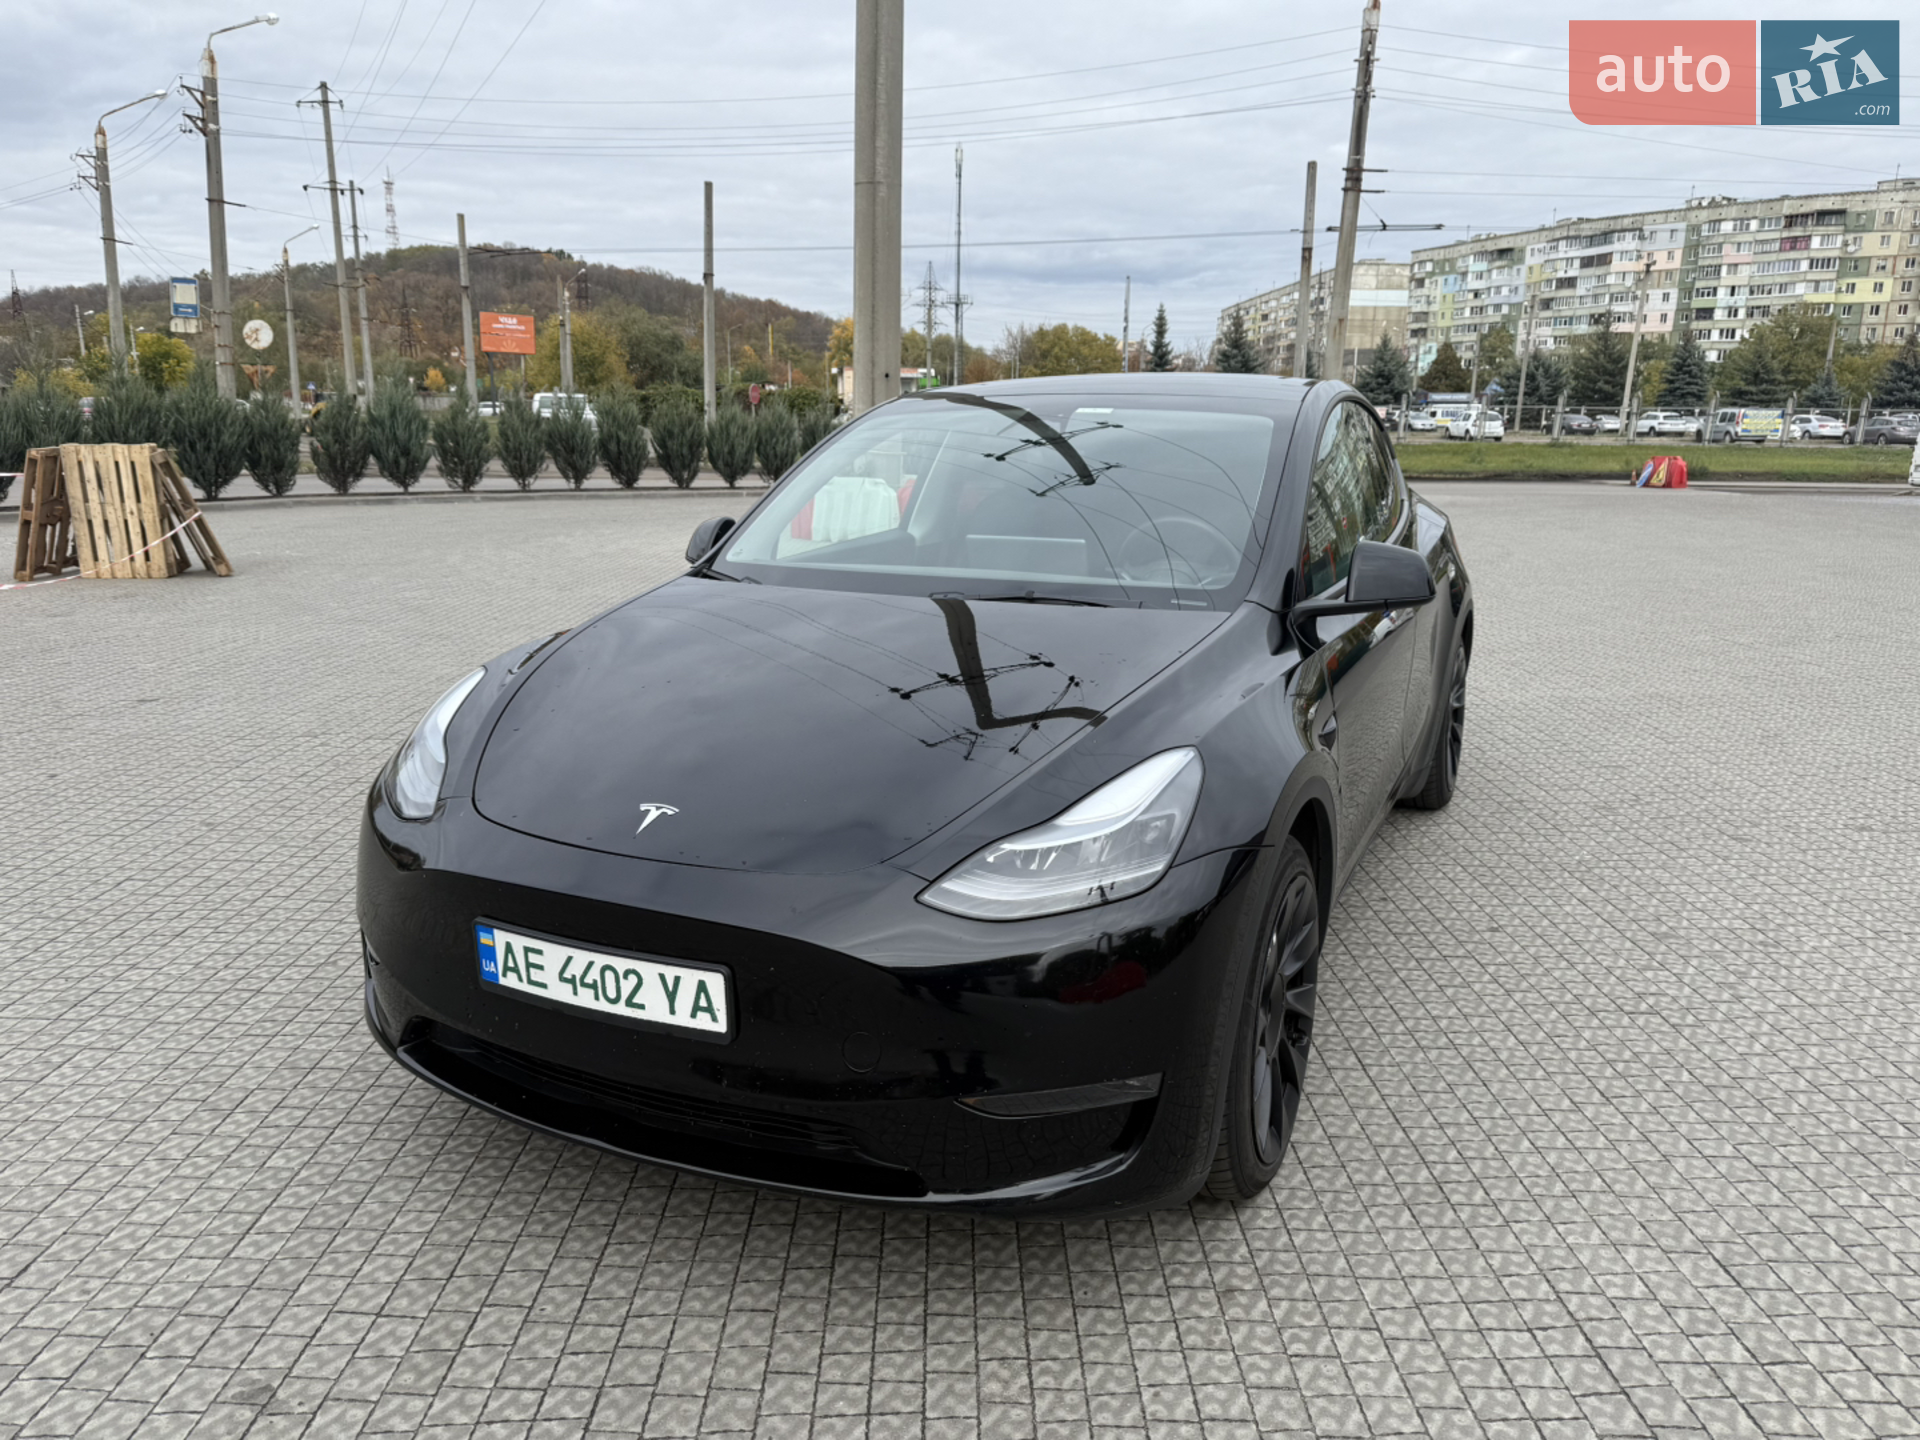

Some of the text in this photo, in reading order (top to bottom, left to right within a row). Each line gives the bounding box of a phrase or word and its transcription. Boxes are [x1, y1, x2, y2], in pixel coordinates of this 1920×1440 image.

[482, 958, 497, 974] UA
[501, 941, 719, 1023] AE 4402 YA
